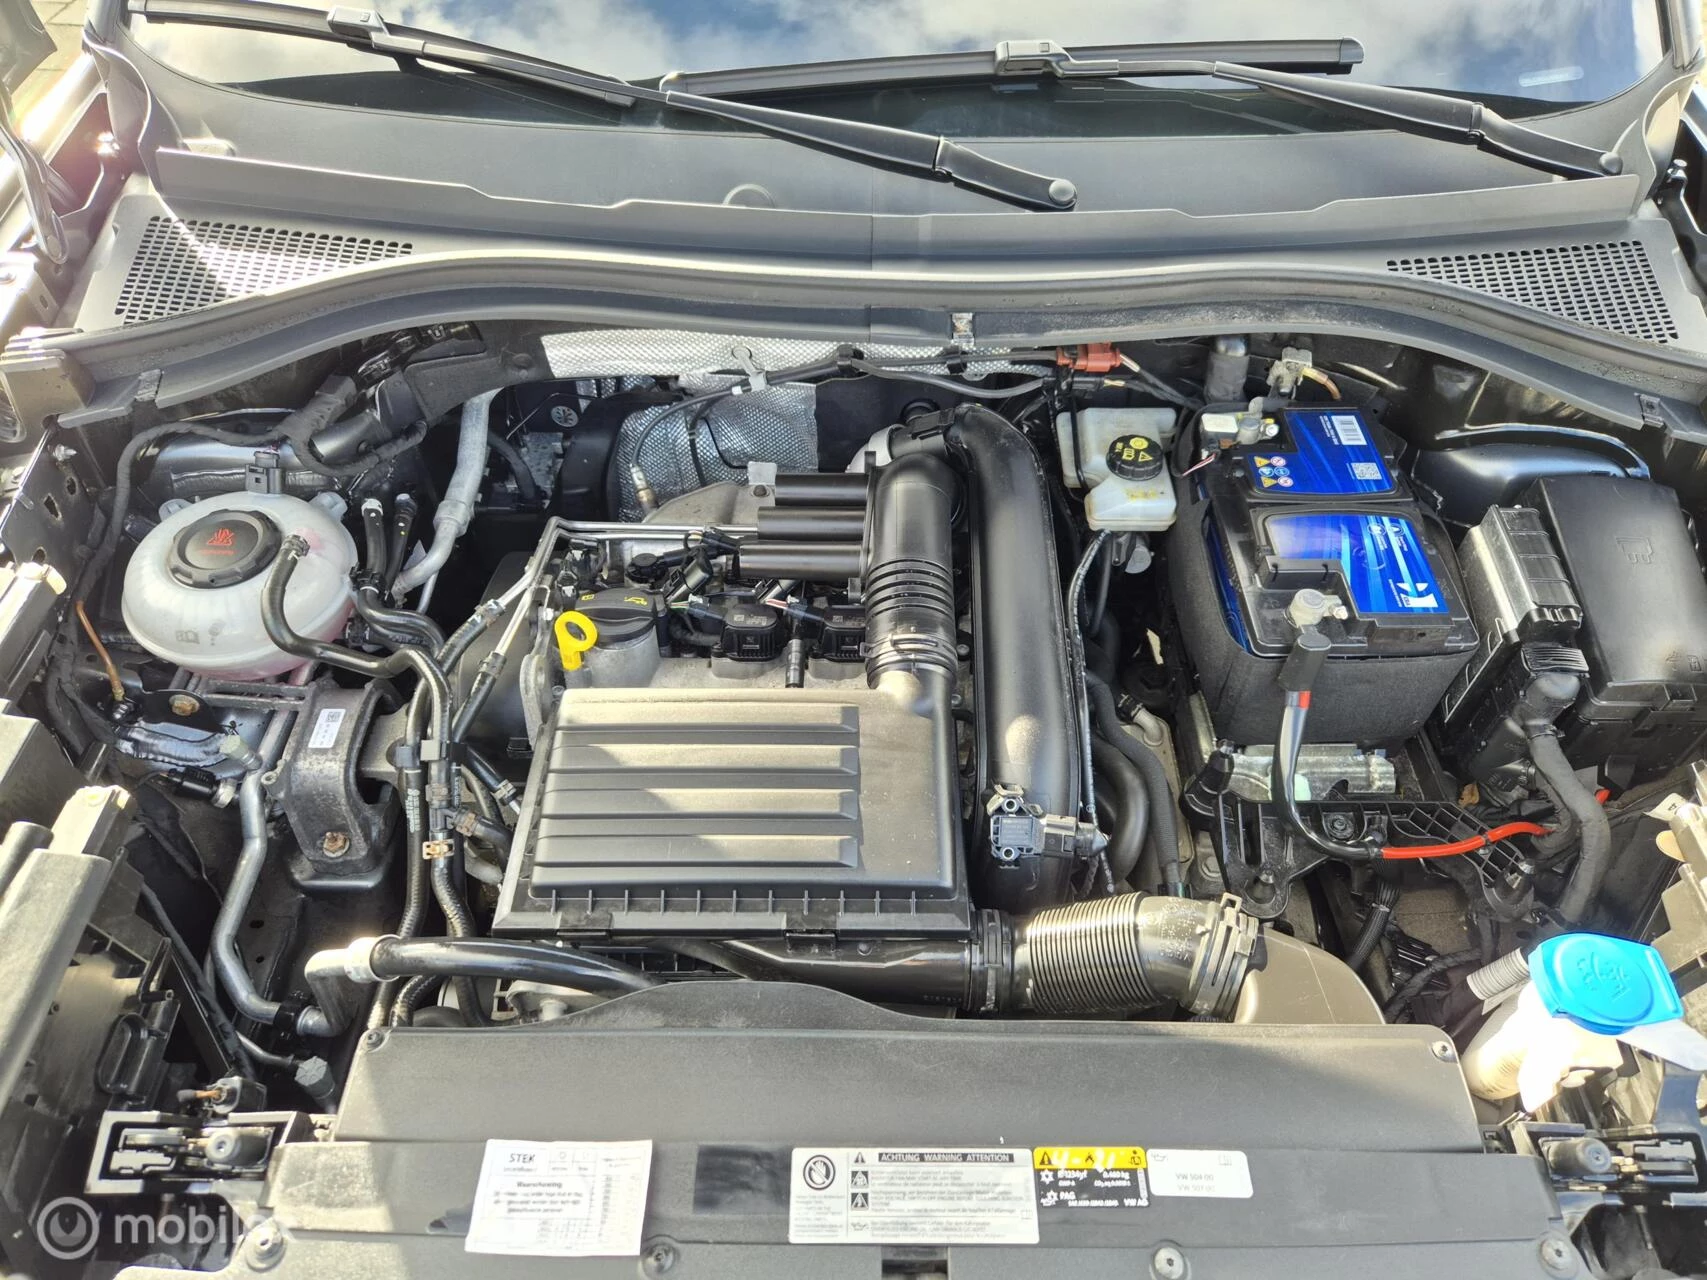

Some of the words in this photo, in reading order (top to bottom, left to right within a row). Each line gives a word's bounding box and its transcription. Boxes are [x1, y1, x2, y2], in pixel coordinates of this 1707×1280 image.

[880, 1153, 920, 1162] ACHTUNG
[923, 1153, 963, 1162] WARNING
[966, 1153, 1010, 1162] ATTENTION
[1175, 1172, 1188, 1181] VW
[1123, 1198, 1136, 1207] VW
[1137, 1198, 1149, 1207] AG
